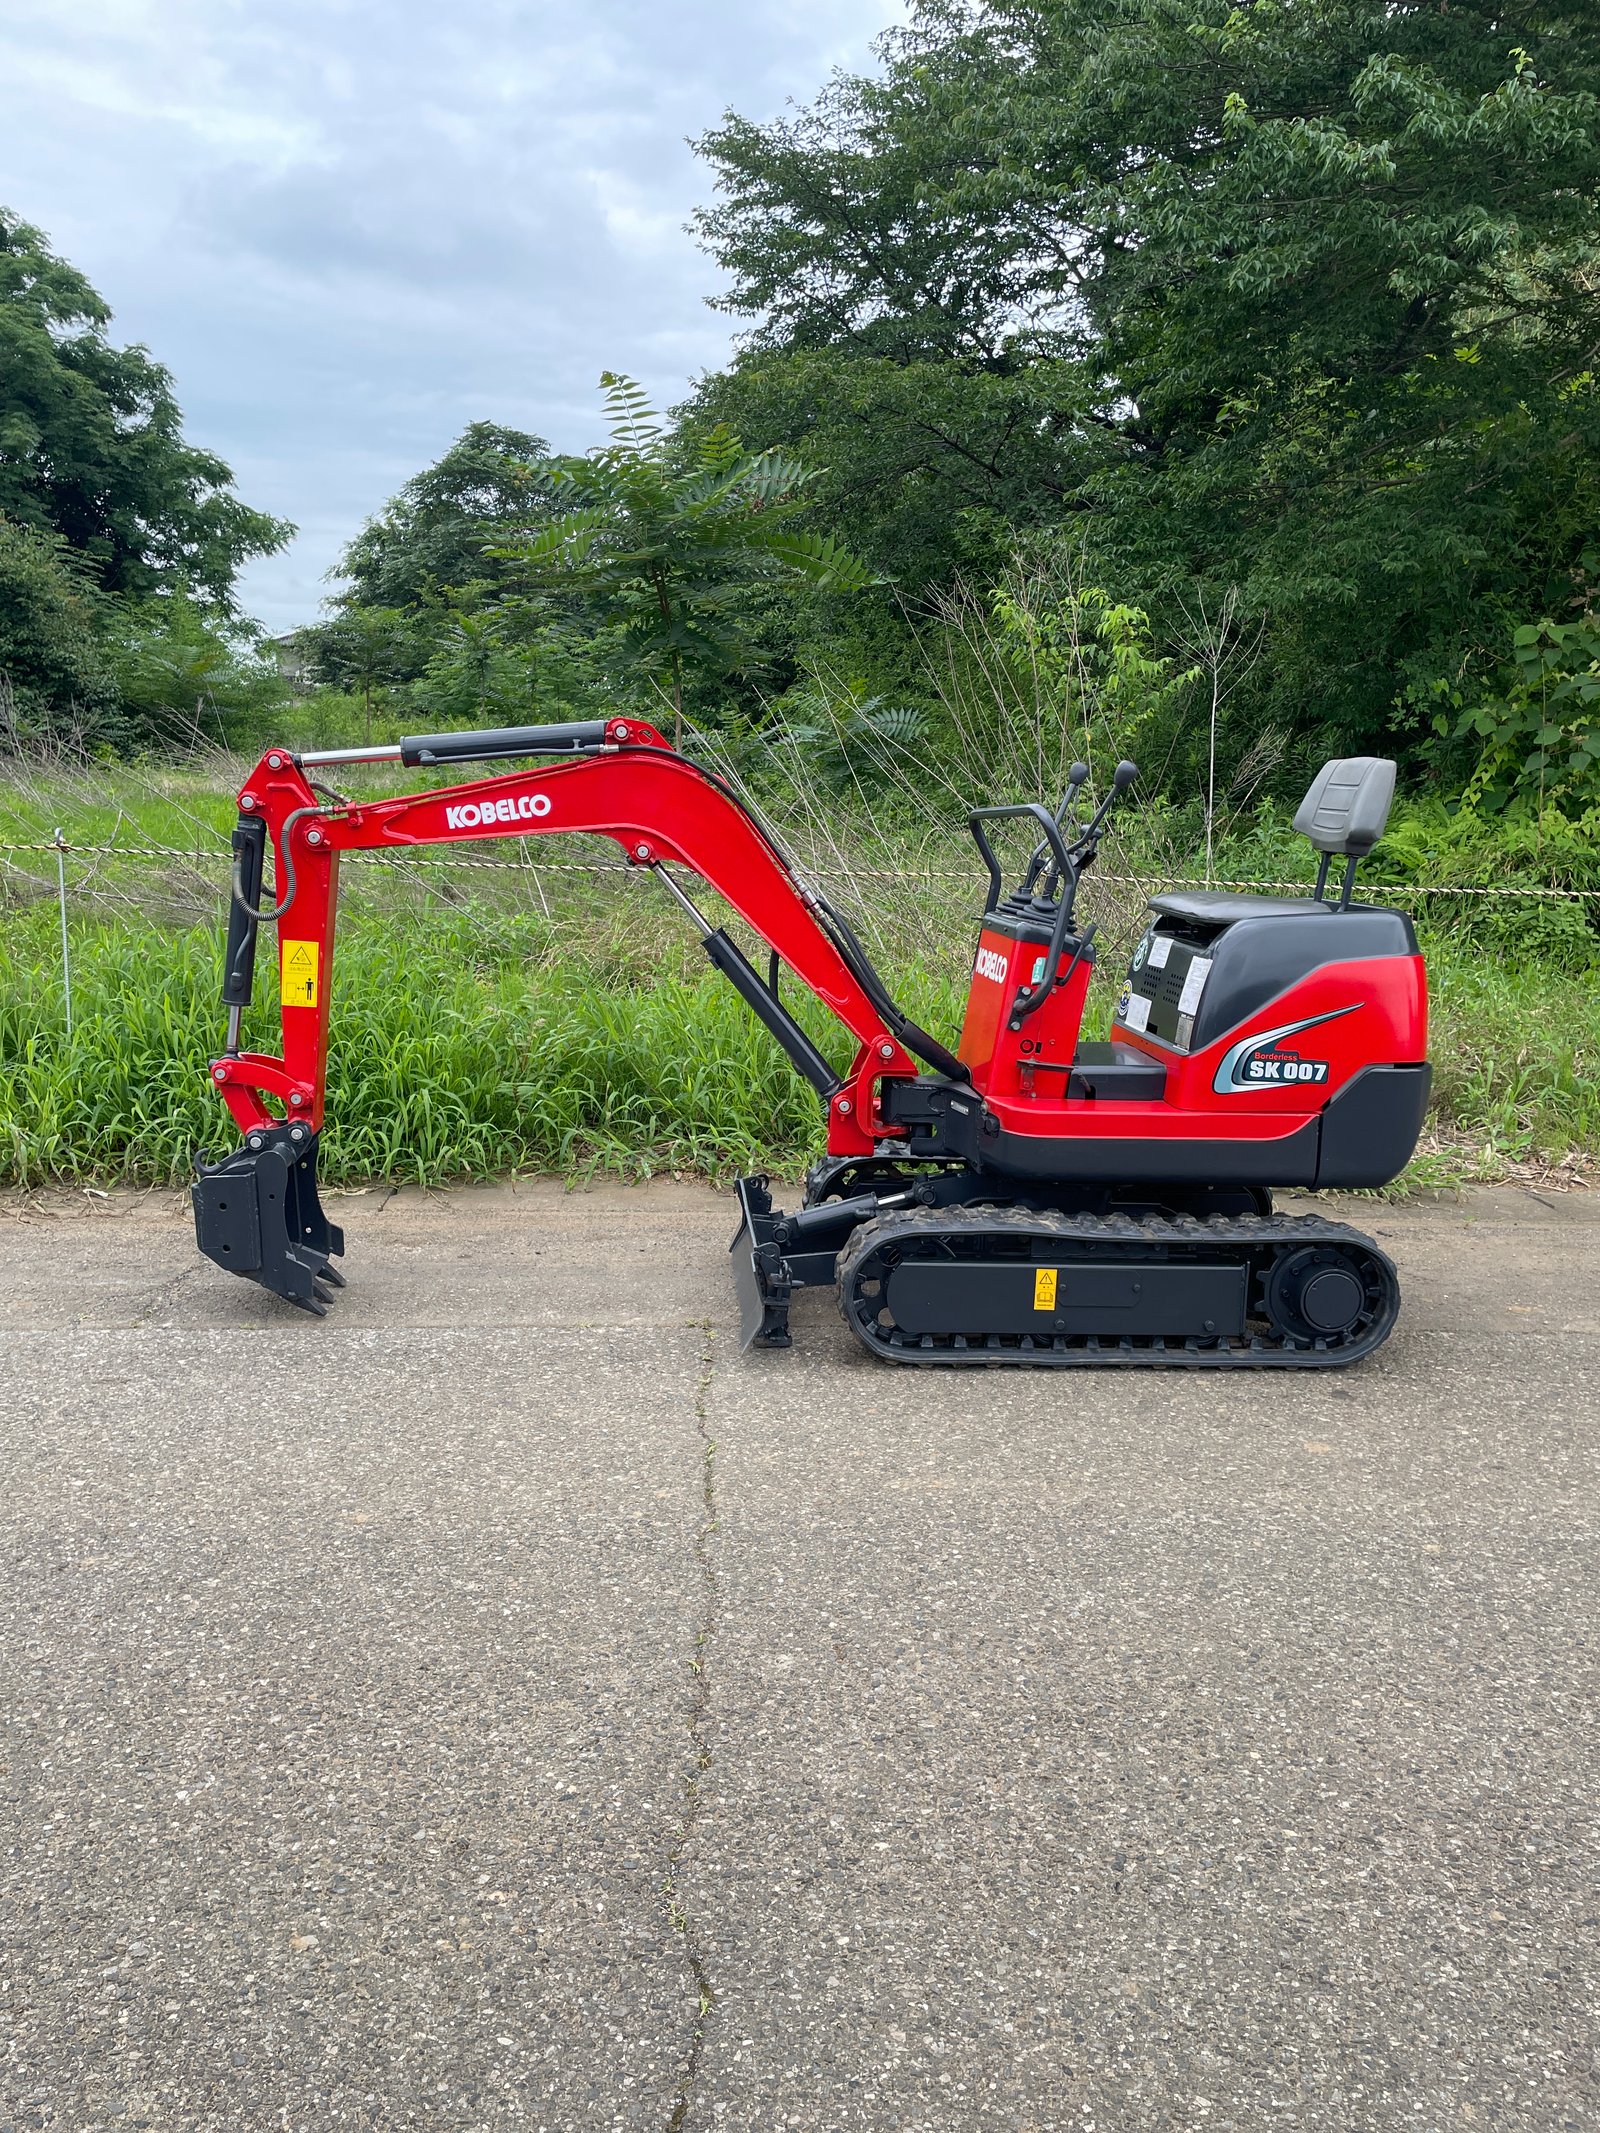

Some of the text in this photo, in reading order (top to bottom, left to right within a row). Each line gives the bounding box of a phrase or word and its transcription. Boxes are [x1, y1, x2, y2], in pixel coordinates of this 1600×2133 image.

[445, 794, 552, 830] KOBELCO
[976, 947, 1008, 984] KOBELCO
[1254, 1052, 1297, 1061] Borderless
[1249, 1061, 1327, 1081] SK 007
